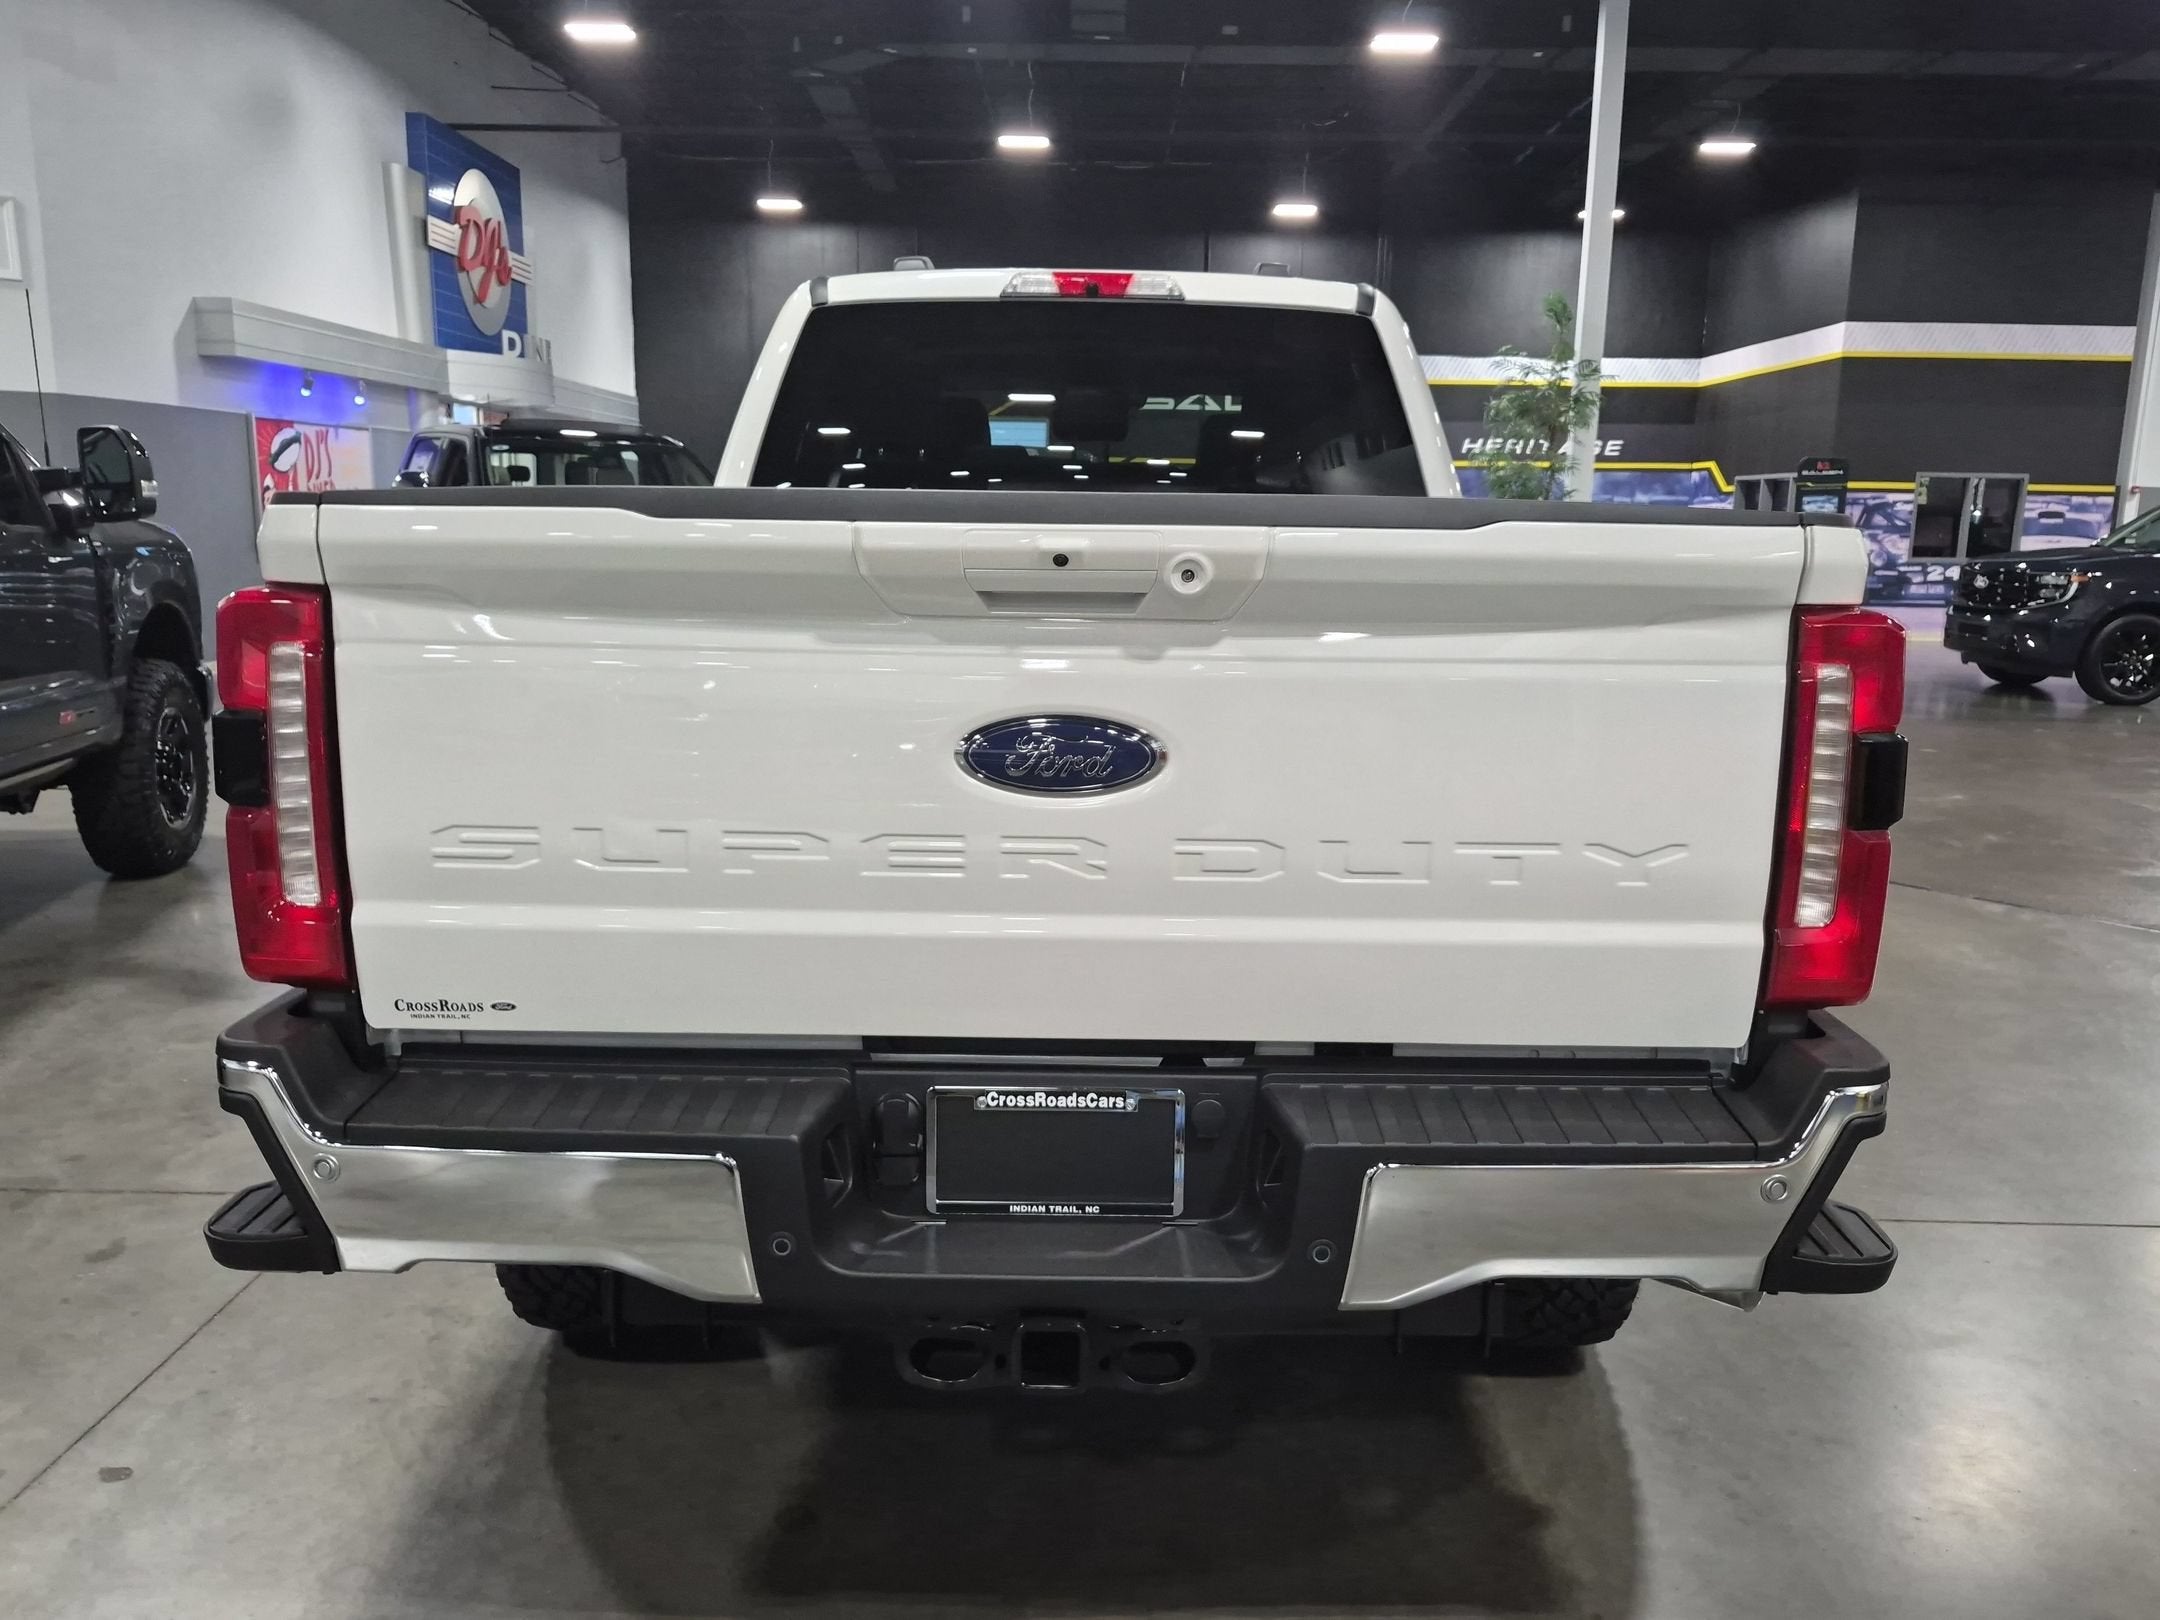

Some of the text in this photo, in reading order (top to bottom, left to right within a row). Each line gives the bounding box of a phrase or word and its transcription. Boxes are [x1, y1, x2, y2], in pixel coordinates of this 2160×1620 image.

[1004, 734, 1118, 778] Ford
[431, 824, 1691, 887] SUPER DUTY
[986, 1091, 1126, 1109] CrossRoadsCars
[1009, 1204, 1100, 1214] INDIAN TRAIL, NC
